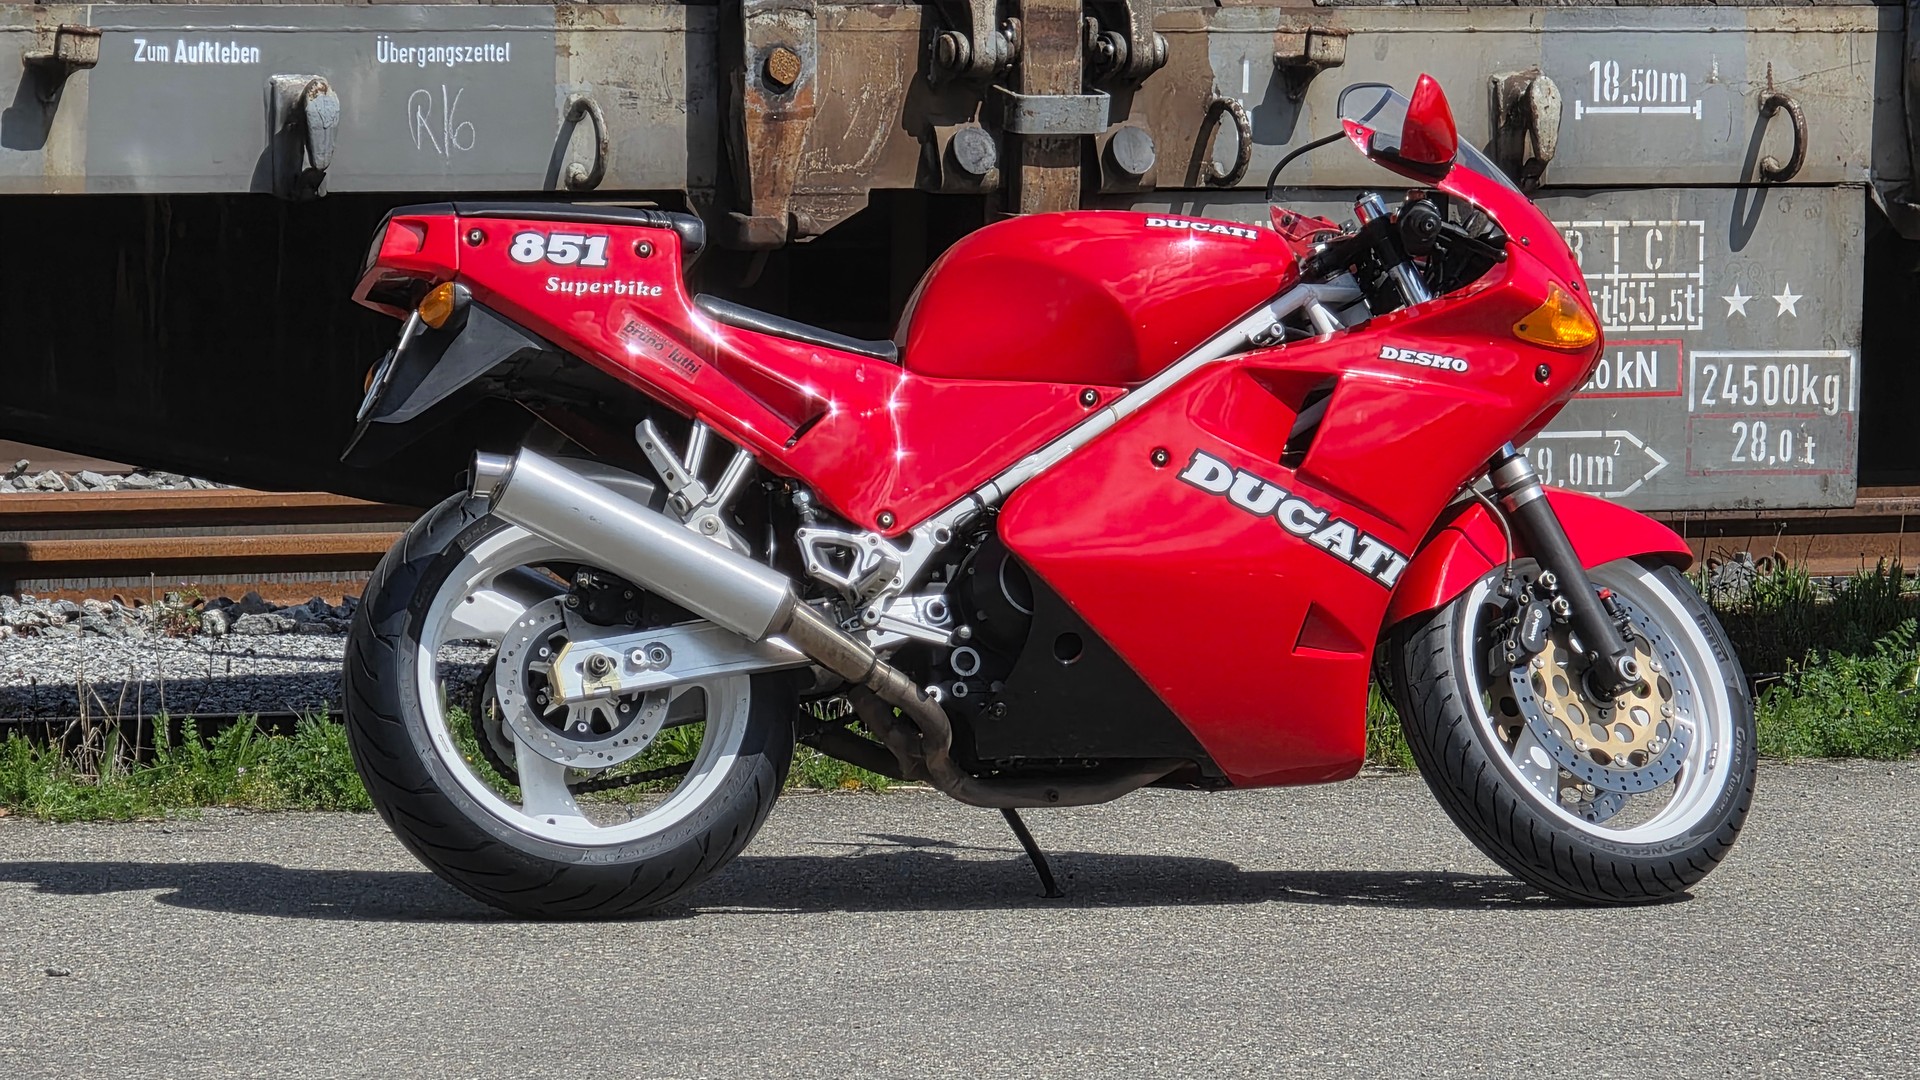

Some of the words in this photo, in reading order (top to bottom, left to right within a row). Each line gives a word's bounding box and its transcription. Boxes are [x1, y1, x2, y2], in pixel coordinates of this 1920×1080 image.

[134, 38, 169, 63] Zum
[174, 39, 260, 64] Aufkleben
[376, 35, 511, 67] Übergangszettel
[1146, 217, 1257, 240] DUCATI
[509, 231, 608, 267] 851
[1645, 228, 1663, 270] C
[545, 277, 663, 297] Superbike
[623, 320, 665, 351] bruno
[1379, 345, 1469, 373] DESMO
[1701, 363, 1841, 416] 24500kg
[1178, 449, 1409, 592] DUCATI
